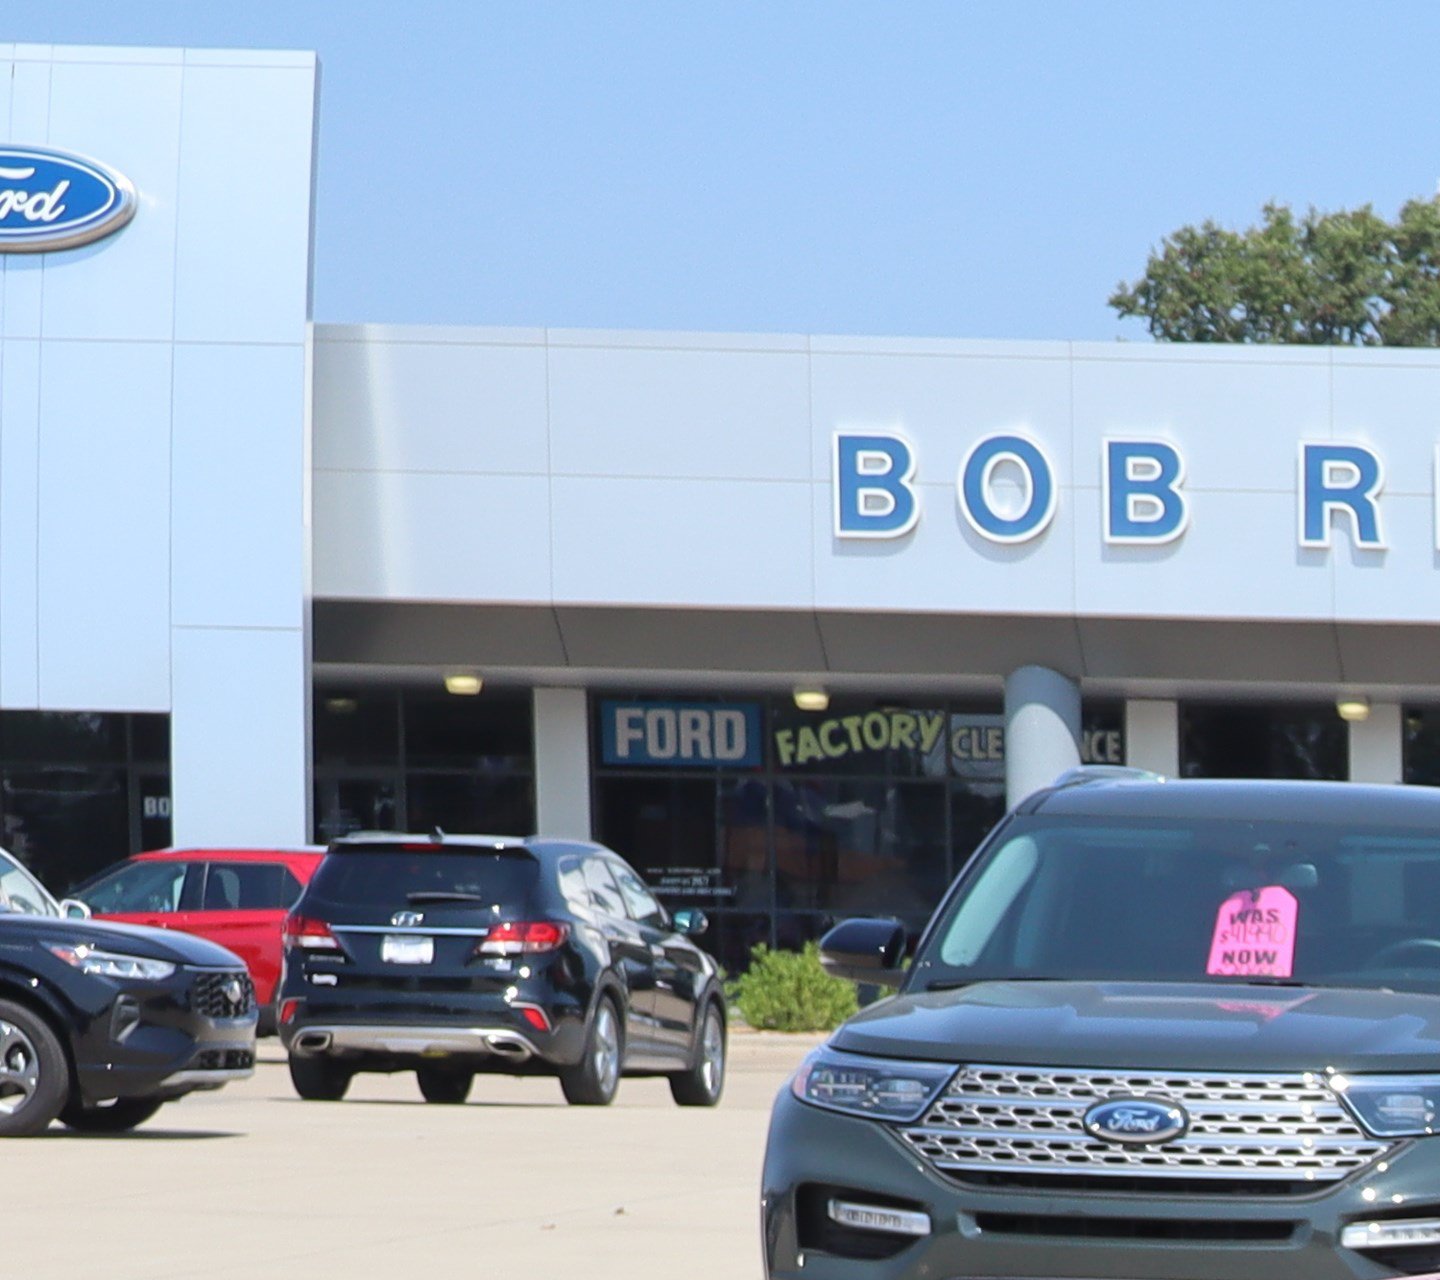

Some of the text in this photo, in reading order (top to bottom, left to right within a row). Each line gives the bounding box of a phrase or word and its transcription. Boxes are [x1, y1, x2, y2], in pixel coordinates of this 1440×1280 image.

[0, 167, 71, 221] rd
[832, 431, 1191, 546] BOB
[613, 706, 748, 761] FORD
[775, 708, 946, 768] FACTORY
[1229, 908, 1280, 925] WAS
[1221, 949, 1278, 965] NOW
[1107, 1108, 1161, 1132] Ford
